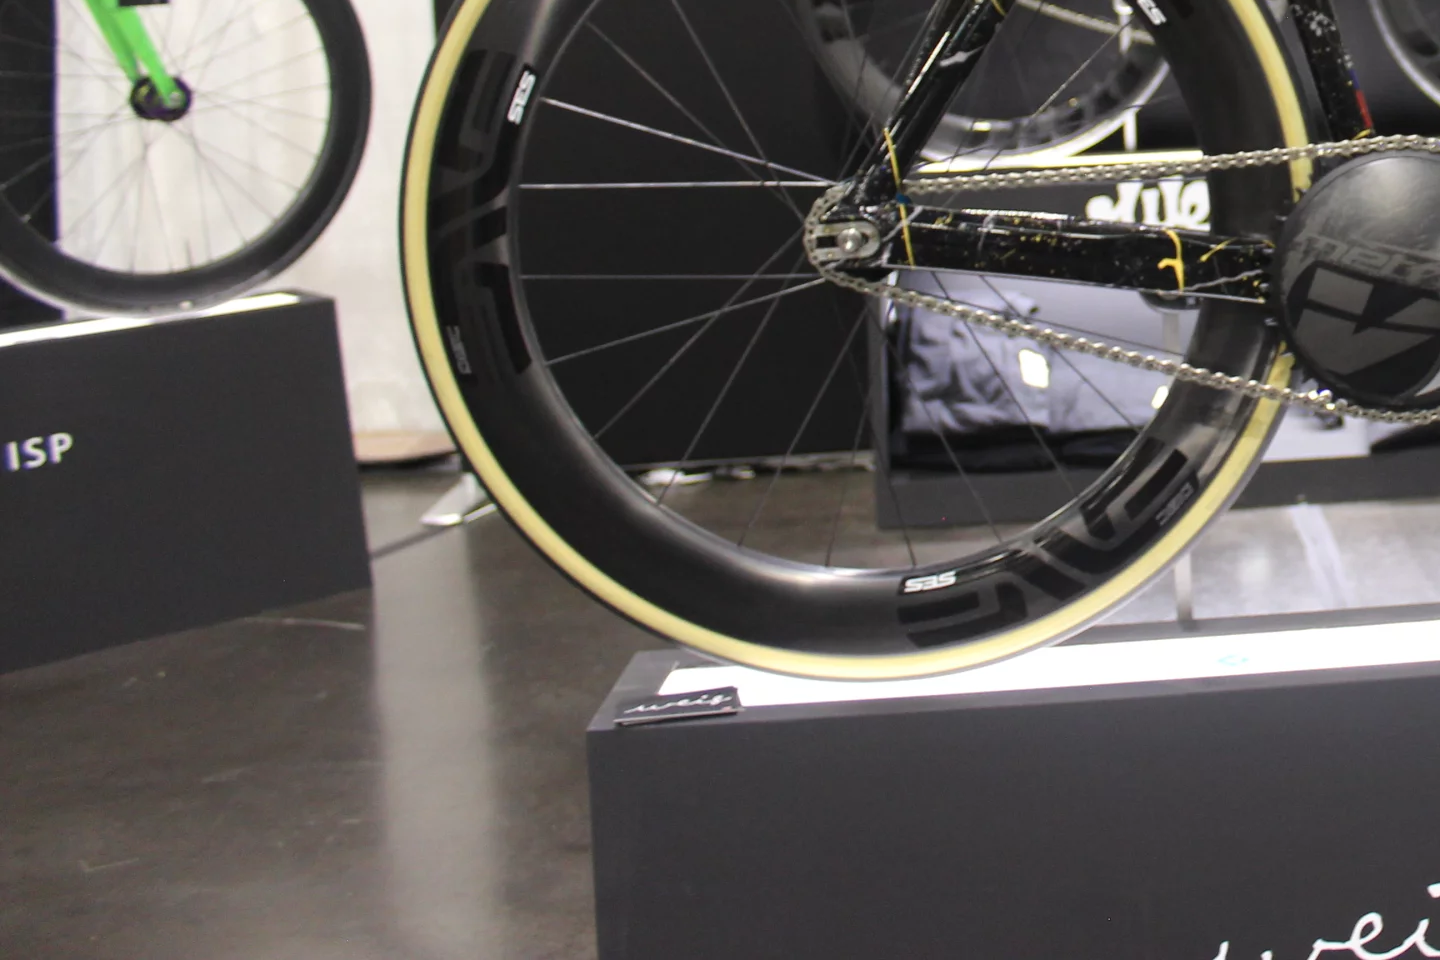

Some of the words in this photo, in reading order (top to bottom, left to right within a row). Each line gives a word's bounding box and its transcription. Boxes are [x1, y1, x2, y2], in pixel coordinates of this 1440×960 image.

[506, 69, 537, 125] SES
[5, 431, 75, 472] ISP
[903, 570, 957, 593] SES
